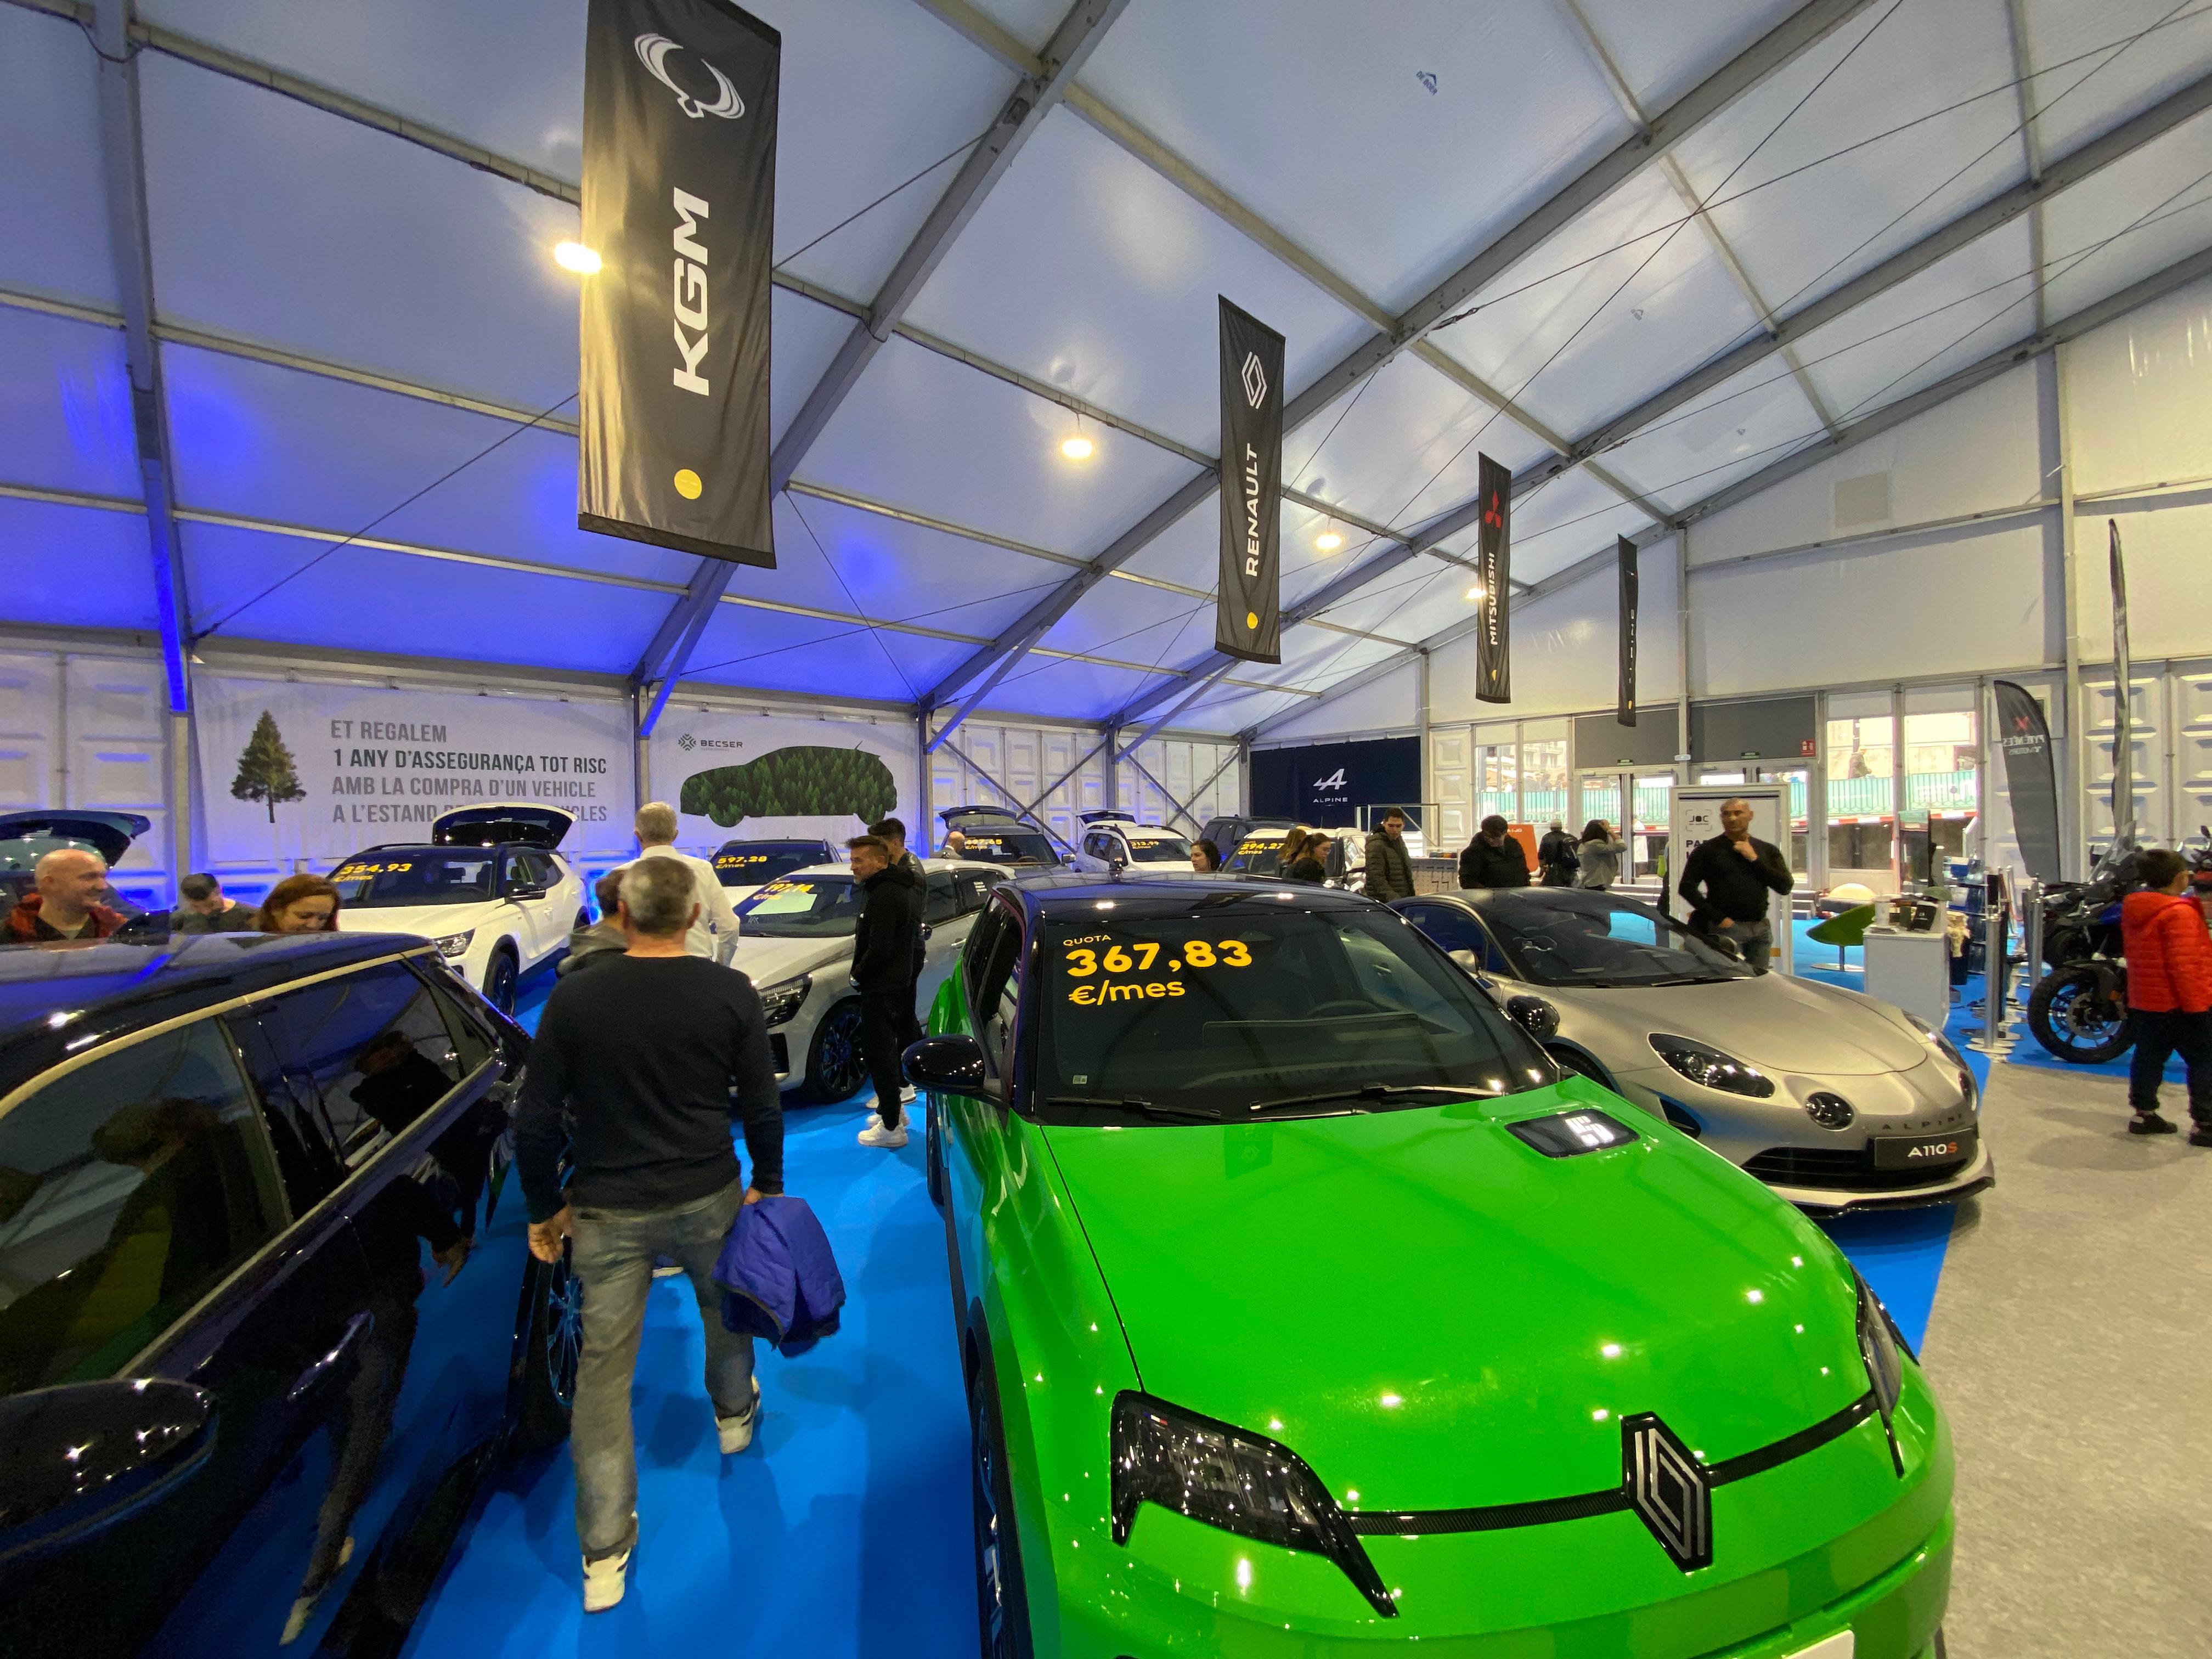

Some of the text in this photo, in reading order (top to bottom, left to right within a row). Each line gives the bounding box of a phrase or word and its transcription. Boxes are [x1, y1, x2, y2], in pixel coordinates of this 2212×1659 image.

[674, 187, 709, 396] KGM
[1245, 443, 1260, 577] RENAULT
[1488, 552, 1498, 645] MITSUBISHI
[331, 720, 447, 742] ET REGALEM
[335, 748, 341, 766] 1
[350, 749, 388, 768] ANY
[540, 755, 568, 772] TOT
[573, 757, 607, 774] RISC
[332, 776, 596, 798] AMB LA COMPRA D'UN VEHICLE
[332, 804, 345, 823] A
[1063, 934, 1112, 947] QUOTA
[1065, 939, 1253, 977] 367,83
[1068, 979, 1186, 1006] €/mes
[1908, 1141, 1958, 1158] A110S
